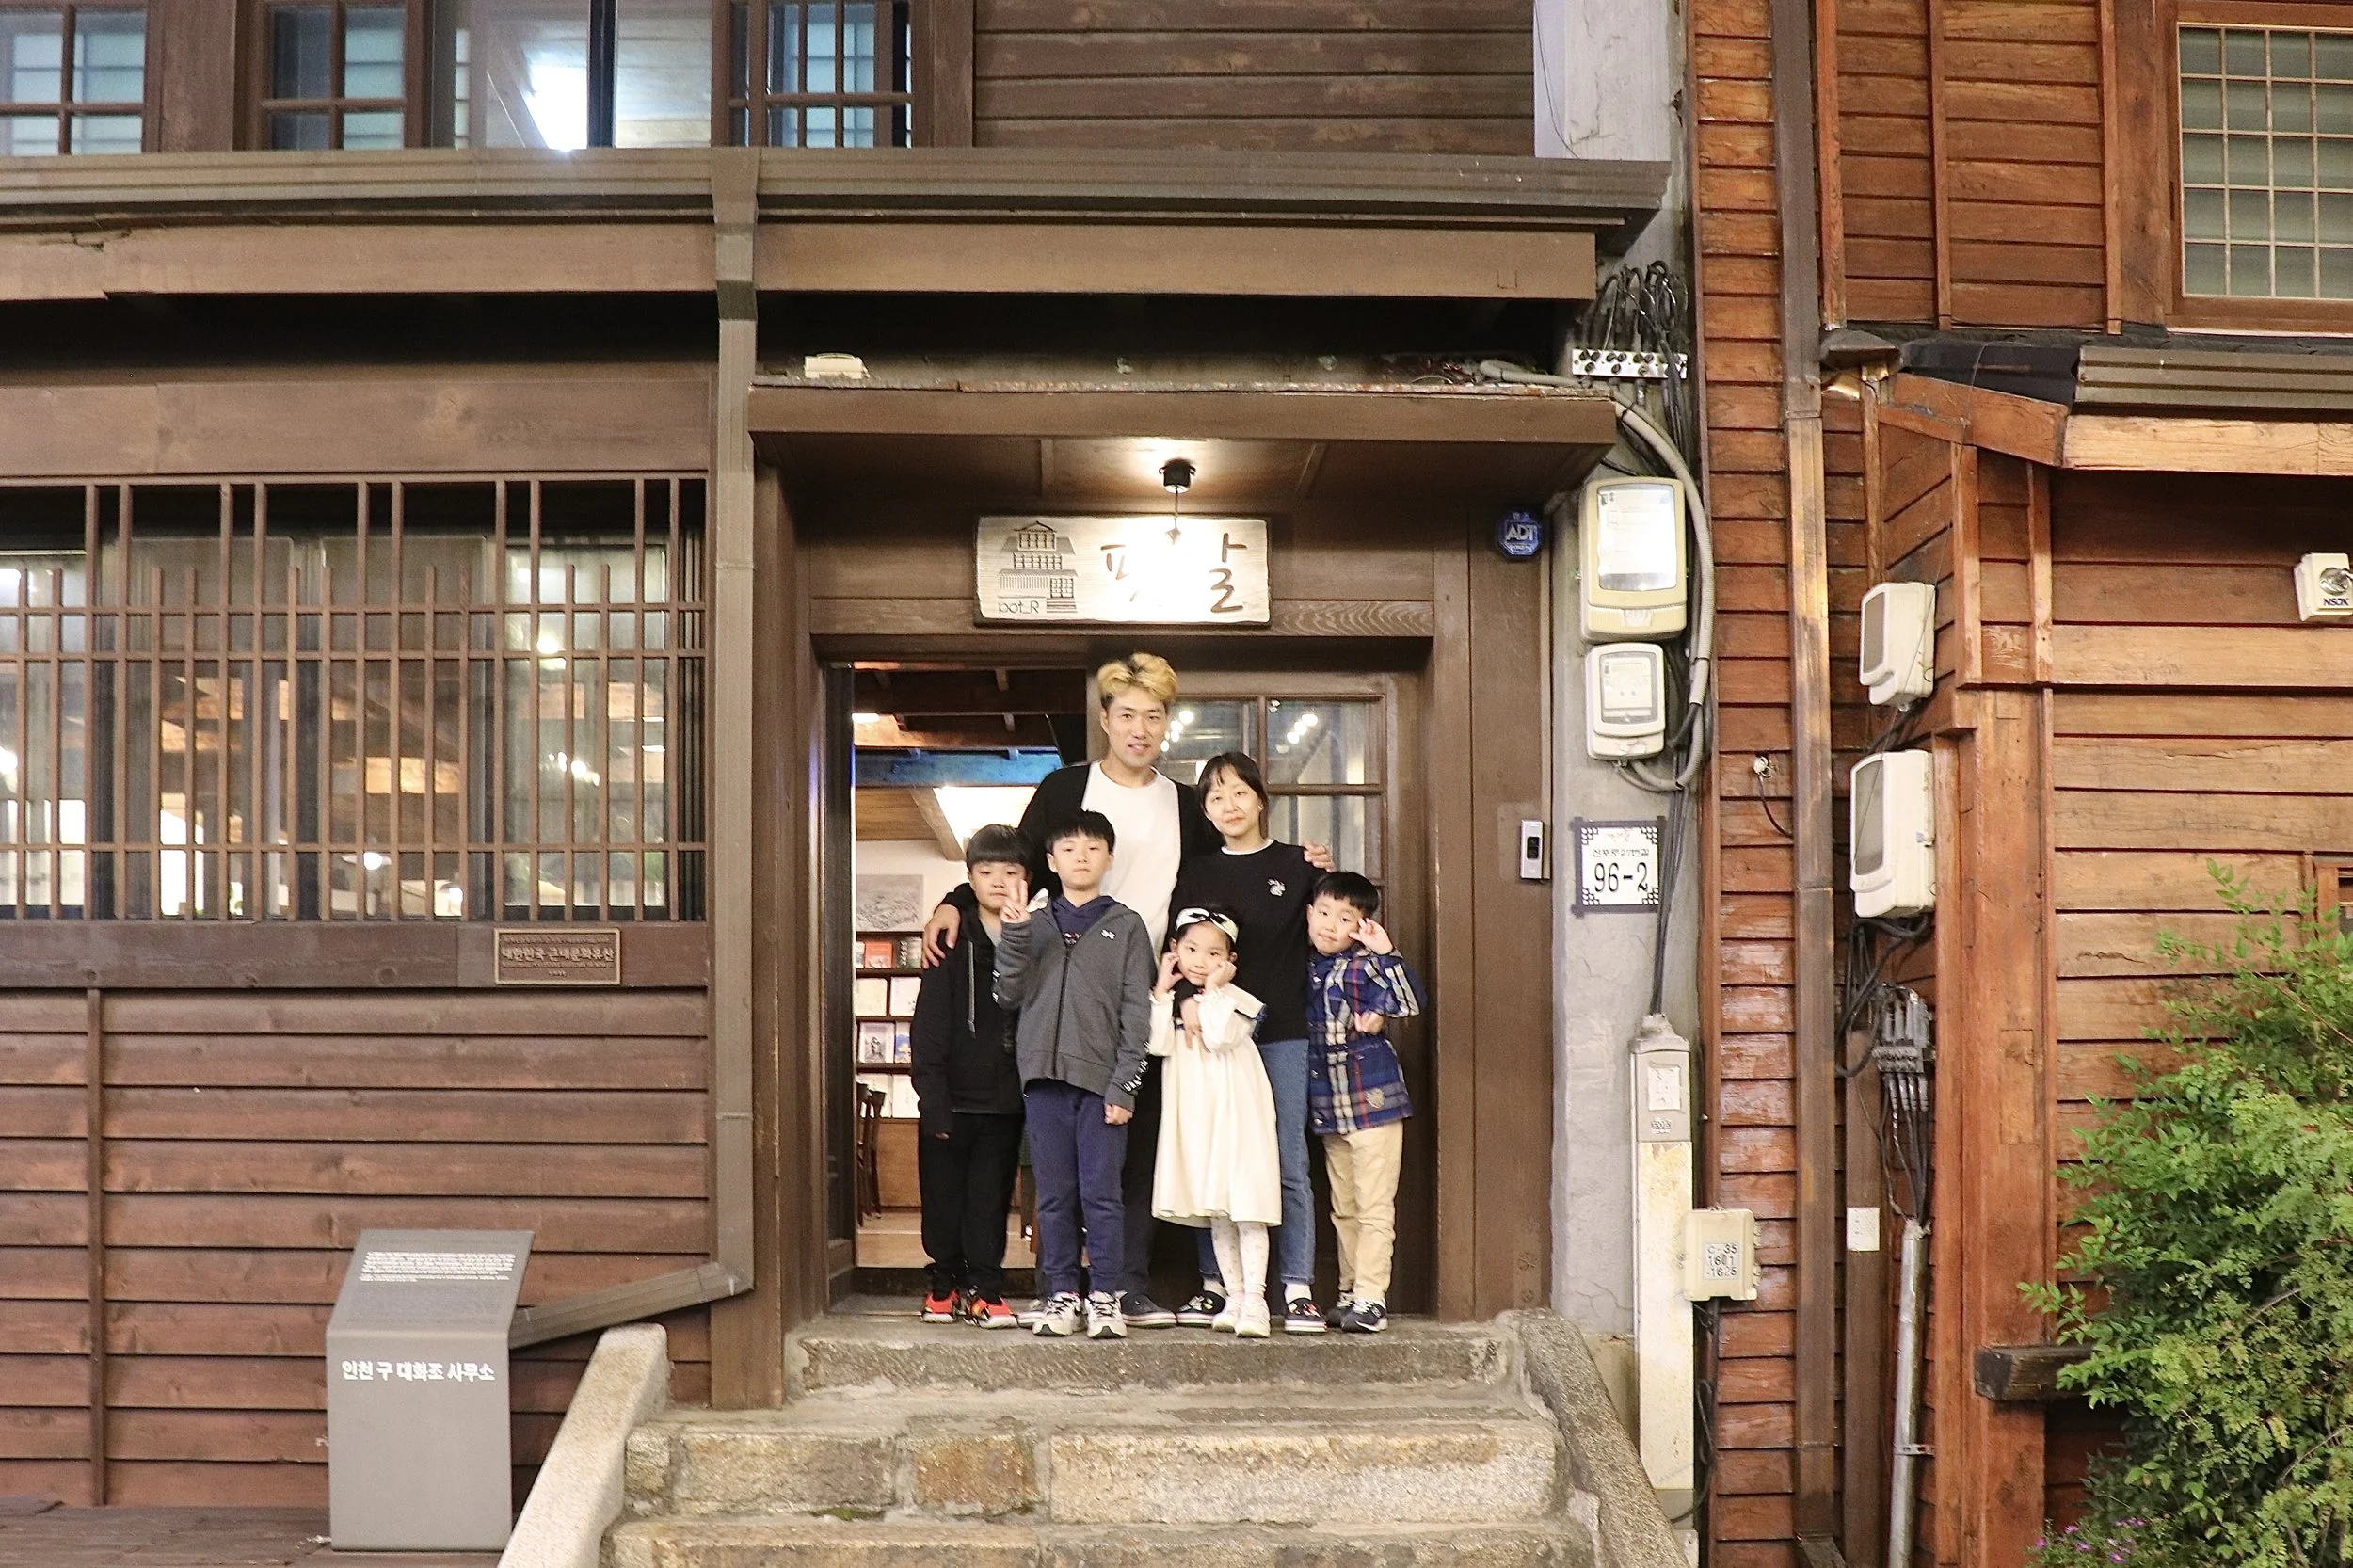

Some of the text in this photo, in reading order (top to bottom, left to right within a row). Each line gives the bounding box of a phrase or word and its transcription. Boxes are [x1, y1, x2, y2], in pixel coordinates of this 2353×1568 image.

[1505, 524, 1537, 541] ADT
[1593, 862, 1649, 893] 96-2
[502, 947, 615, 962] 대한민국 근대문화유산
[341, 1360, 496, 1382] 인천 구 대화조 사무소
